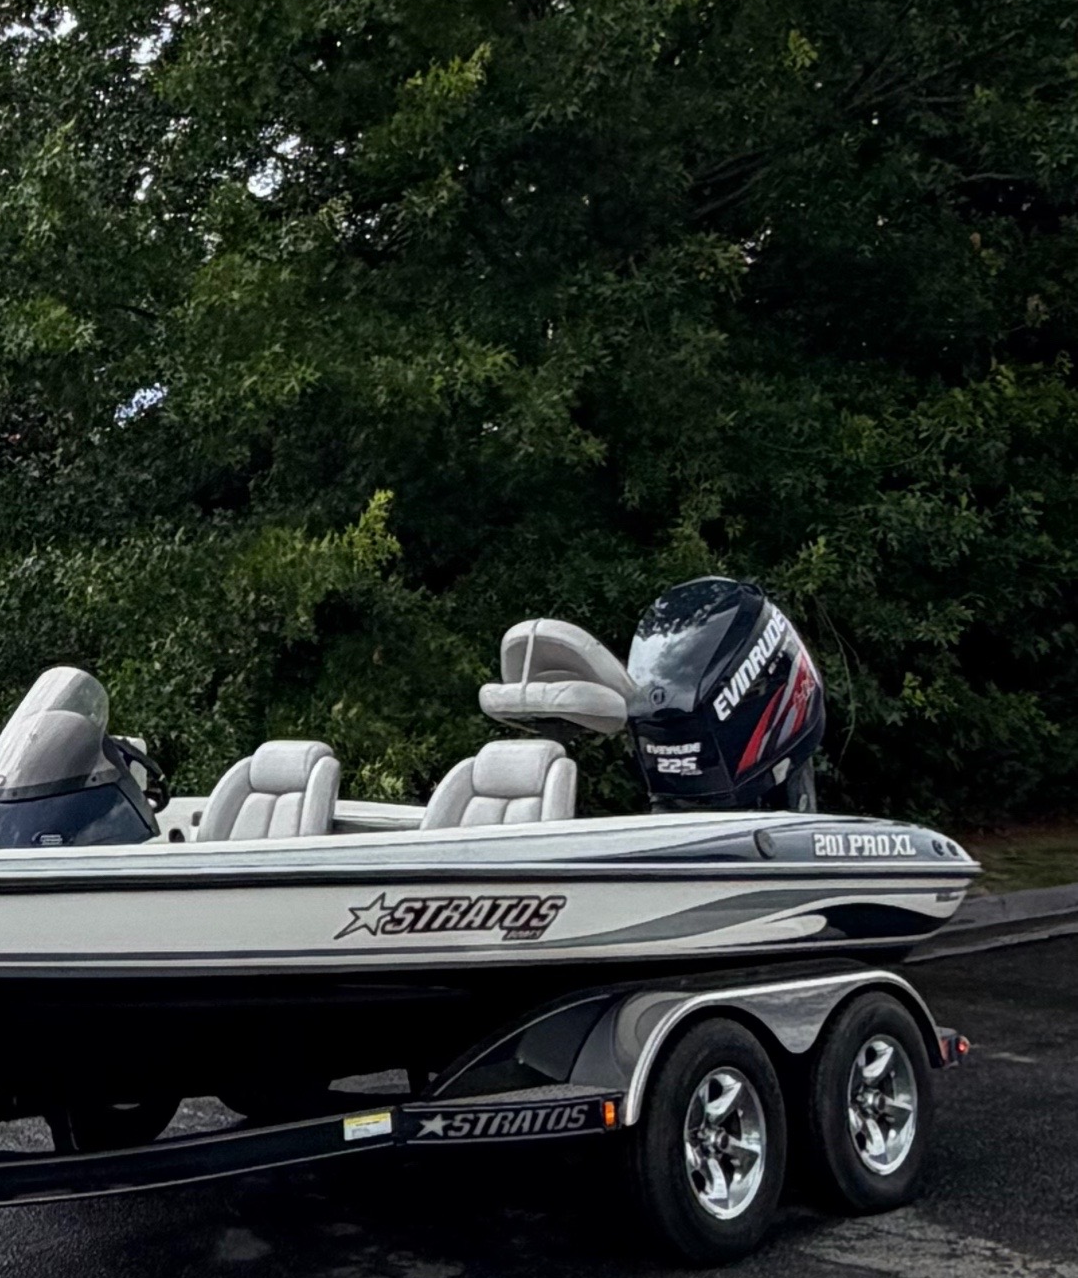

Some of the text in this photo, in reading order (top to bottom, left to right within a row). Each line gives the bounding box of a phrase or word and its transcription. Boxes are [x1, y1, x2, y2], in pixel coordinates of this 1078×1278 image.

[713, 609, 787, 721] EVINRUDE
[657, 757, 697, 773] 225
[814, 833, 846, 856] 201
[381, 896, 567, 934] STRATOS
[447, 1104, 589, 1137] STRATOS
